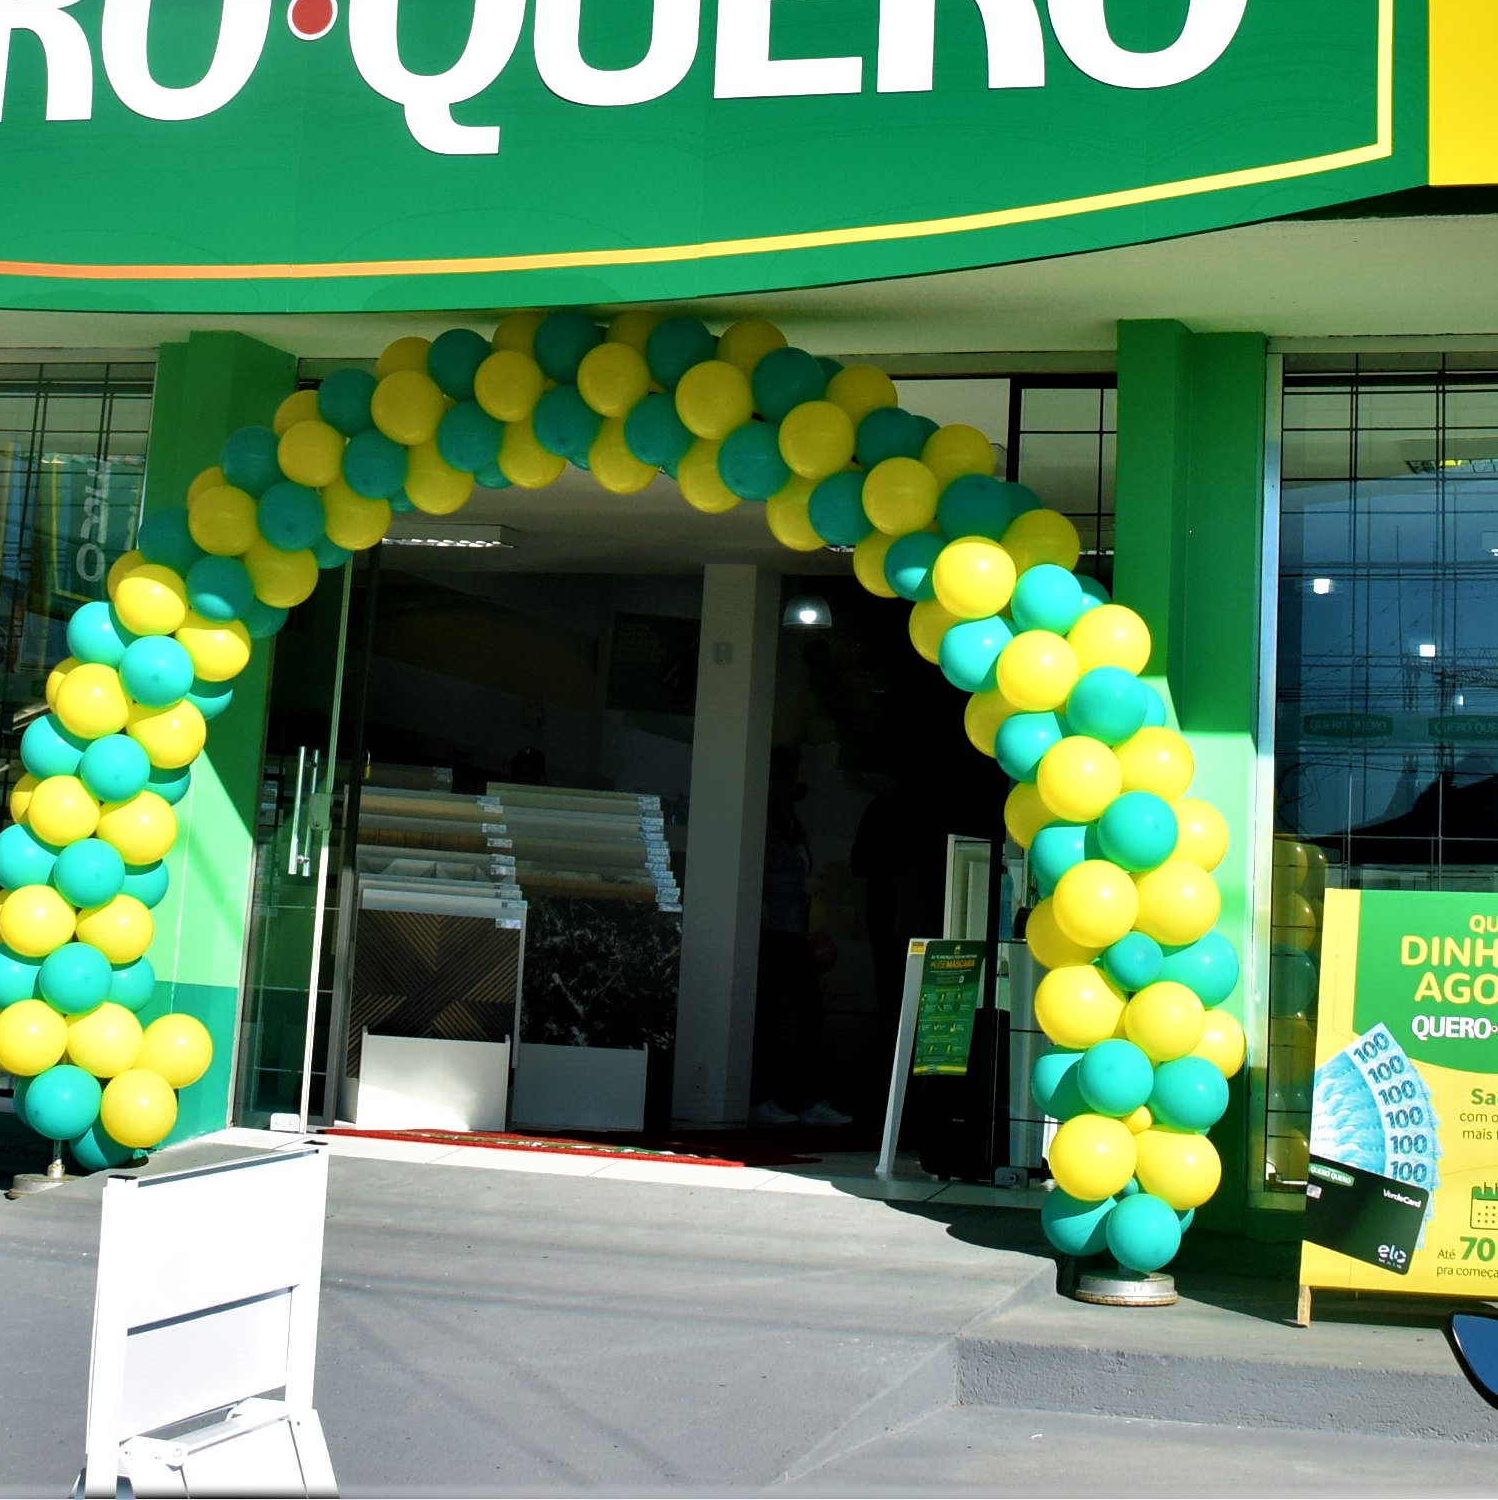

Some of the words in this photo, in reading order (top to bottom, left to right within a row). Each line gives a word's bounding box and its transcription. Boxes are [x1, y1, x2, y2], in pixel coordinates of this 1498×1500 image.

[1353, 1032, 1390, 1064] 100
[1367, 1055, 1405, 1084] 100
[1378, 1079, 1417, 1106] 100
[1385, 1106, 1424, 1129] 100
[1460, 1113, 1488, 1123] com
[1390, 1134, 1428, 1155] 100
[1462, 1129, 1492, 1140] mais
[1390, 1160, 1428, 1183] 100
[1378, 1244, 1407, 1264] elo
[1437, 1249, 1456, 1260] Até
[1460, 1236, 1496, 1262] 70
[1436, 1266, 1453, 1277] pra
